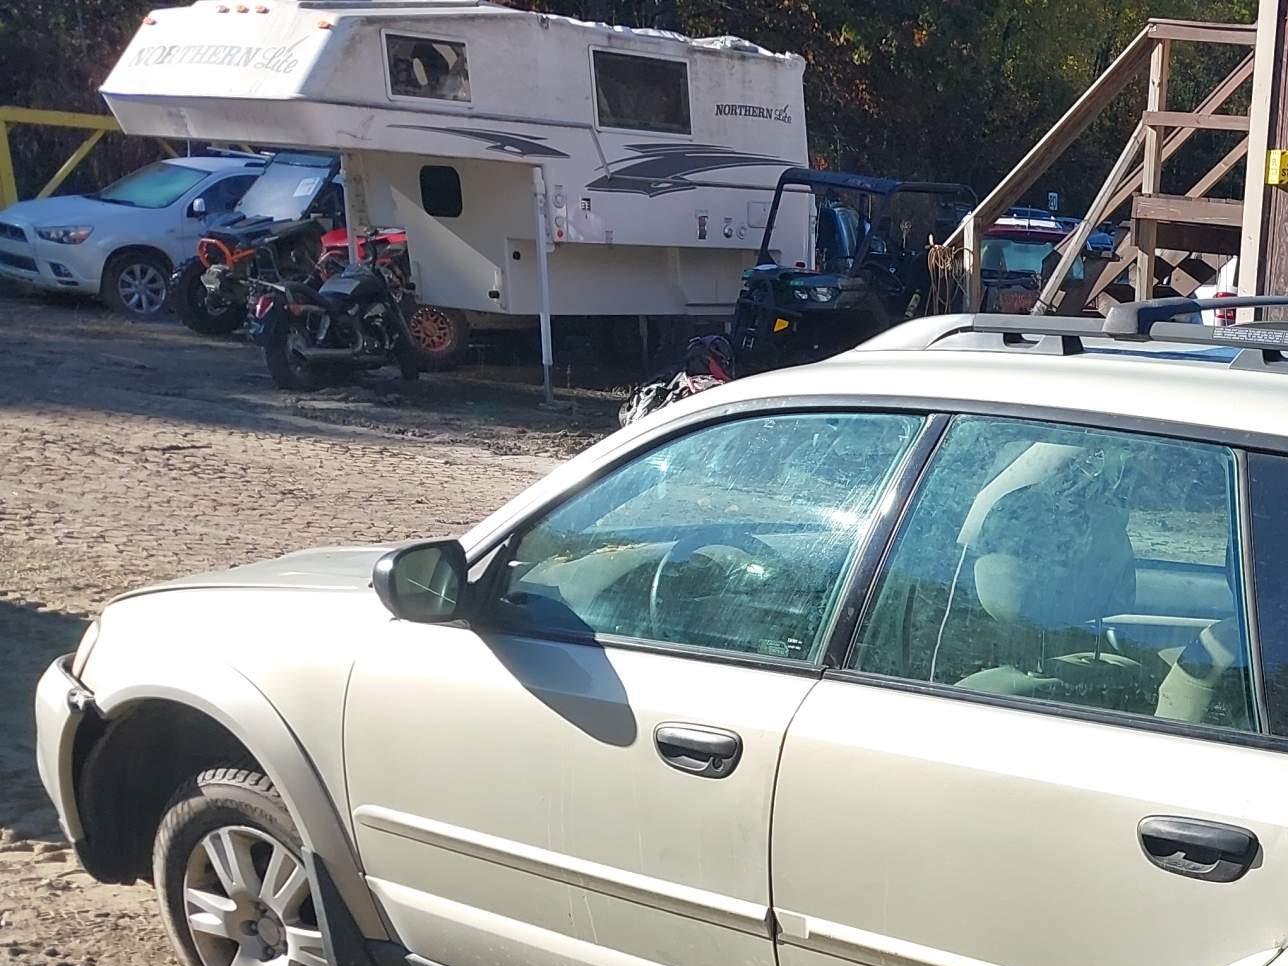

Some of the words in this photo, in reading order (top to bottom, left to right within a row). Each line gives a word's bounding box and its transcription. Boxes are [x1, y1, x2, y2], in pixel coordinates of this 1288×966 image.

[128, 45, 261, 67] NORTHERN
[254, 40, 304, 74] Lite
[715, 104, 773, 119] NORTHERN
